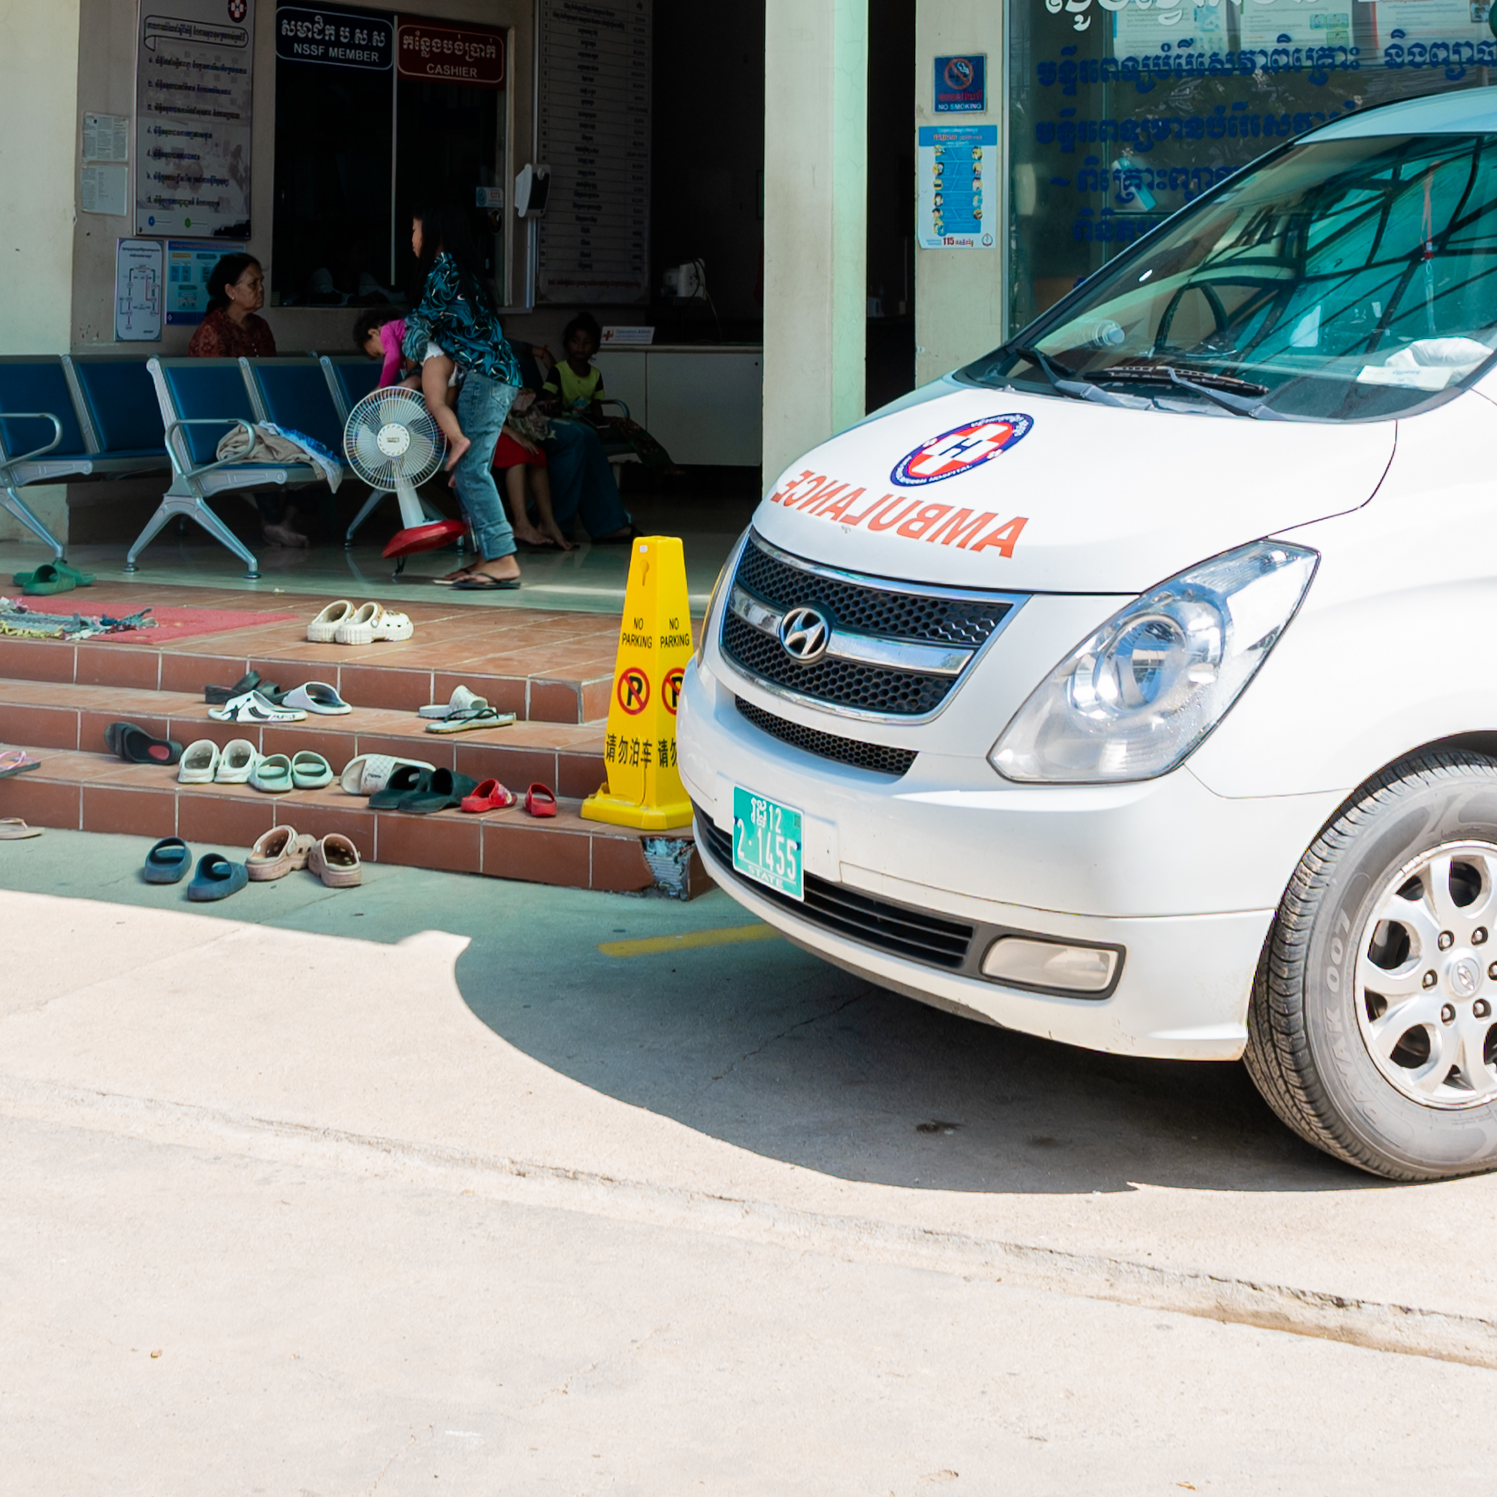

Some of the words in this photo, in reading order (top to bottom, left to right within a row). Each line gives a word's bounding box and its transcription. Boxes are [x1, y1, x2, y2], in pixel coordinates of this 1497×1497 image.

[281, 15, 336, 41] សមាជិក
[339, 26, 386, 48] ប.ស.ស
[293, 42, 325, 57] NSSF
[328, 46, 379, 63] MEMBER
[402, 30, 497, 62] កន្លែងបង់ប្រាក់
[426, 63, 478, 78] CASHIER
[633, 617, 644, 631] NO
[669, 617, 680, 631] NO
[621, 633, 653, 649] PARKING
[660, 633, 690, 649] PARKING
[605, 733, 653, 769] 请勿泊车
[769, 804, 782, 834] 12
[748, 865, 785, 889] STATE
